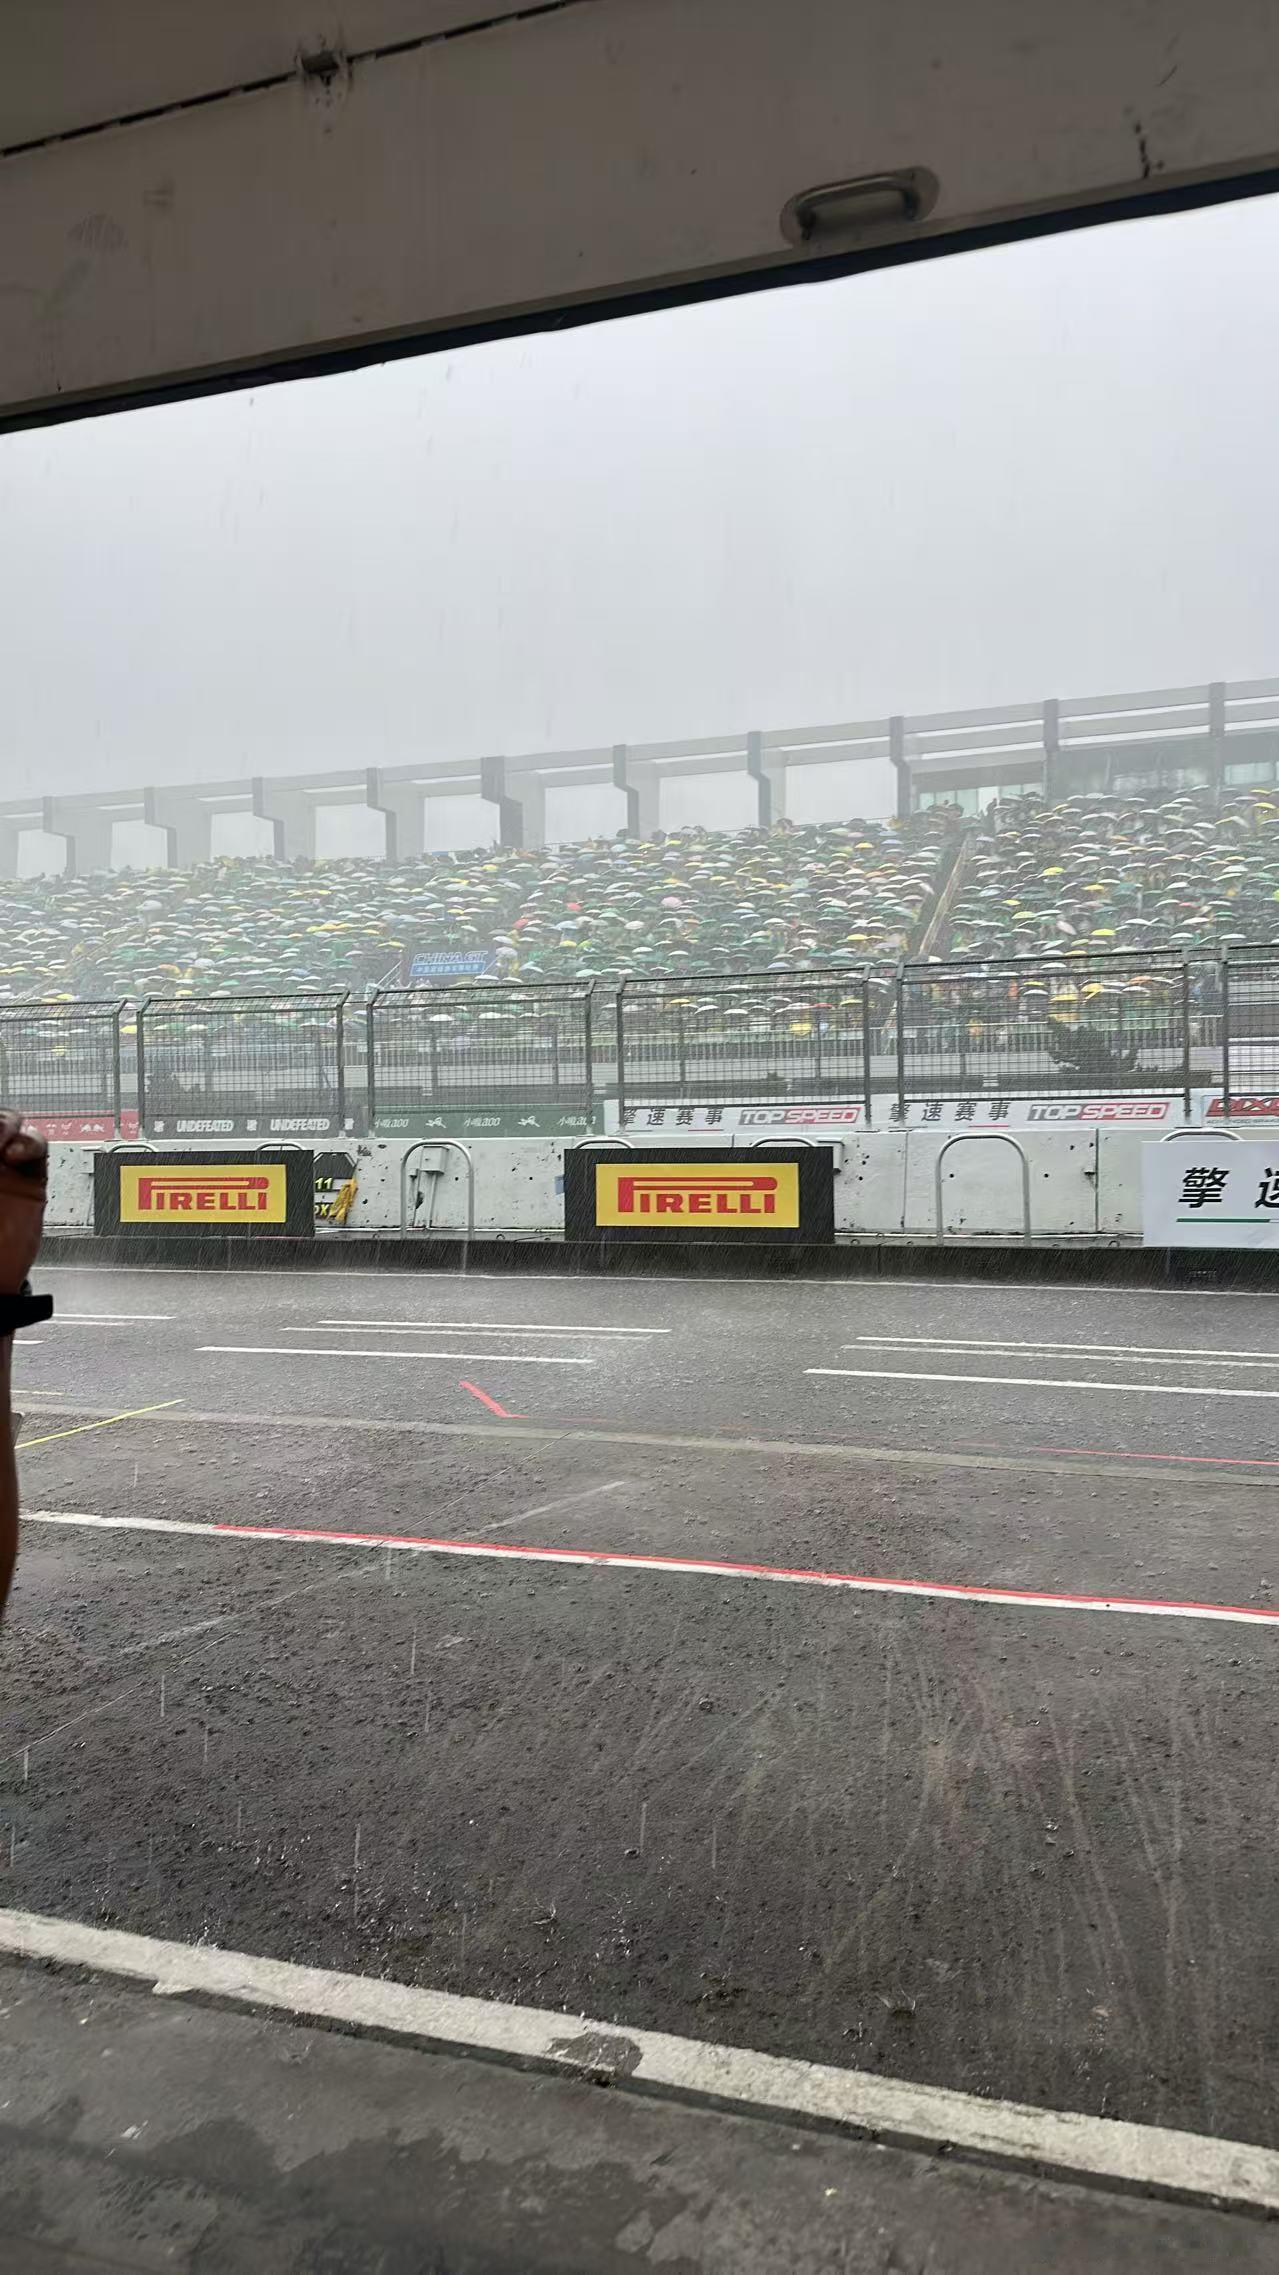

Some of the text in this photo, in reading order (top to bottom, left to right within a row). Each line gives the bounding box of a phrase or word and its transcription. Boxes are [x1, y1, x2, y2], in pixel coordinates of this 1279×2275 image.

[464, 950, 488, 962] GT
[888, 1101, 1011, 1122] 擎速赛事
[176, 1118, 330, 1132] UNDEFEATED UNDEFEATED
[138, 1177, 269, 1210] PIRELLI
[618, 1176, 777, 1213] PIRELLI
